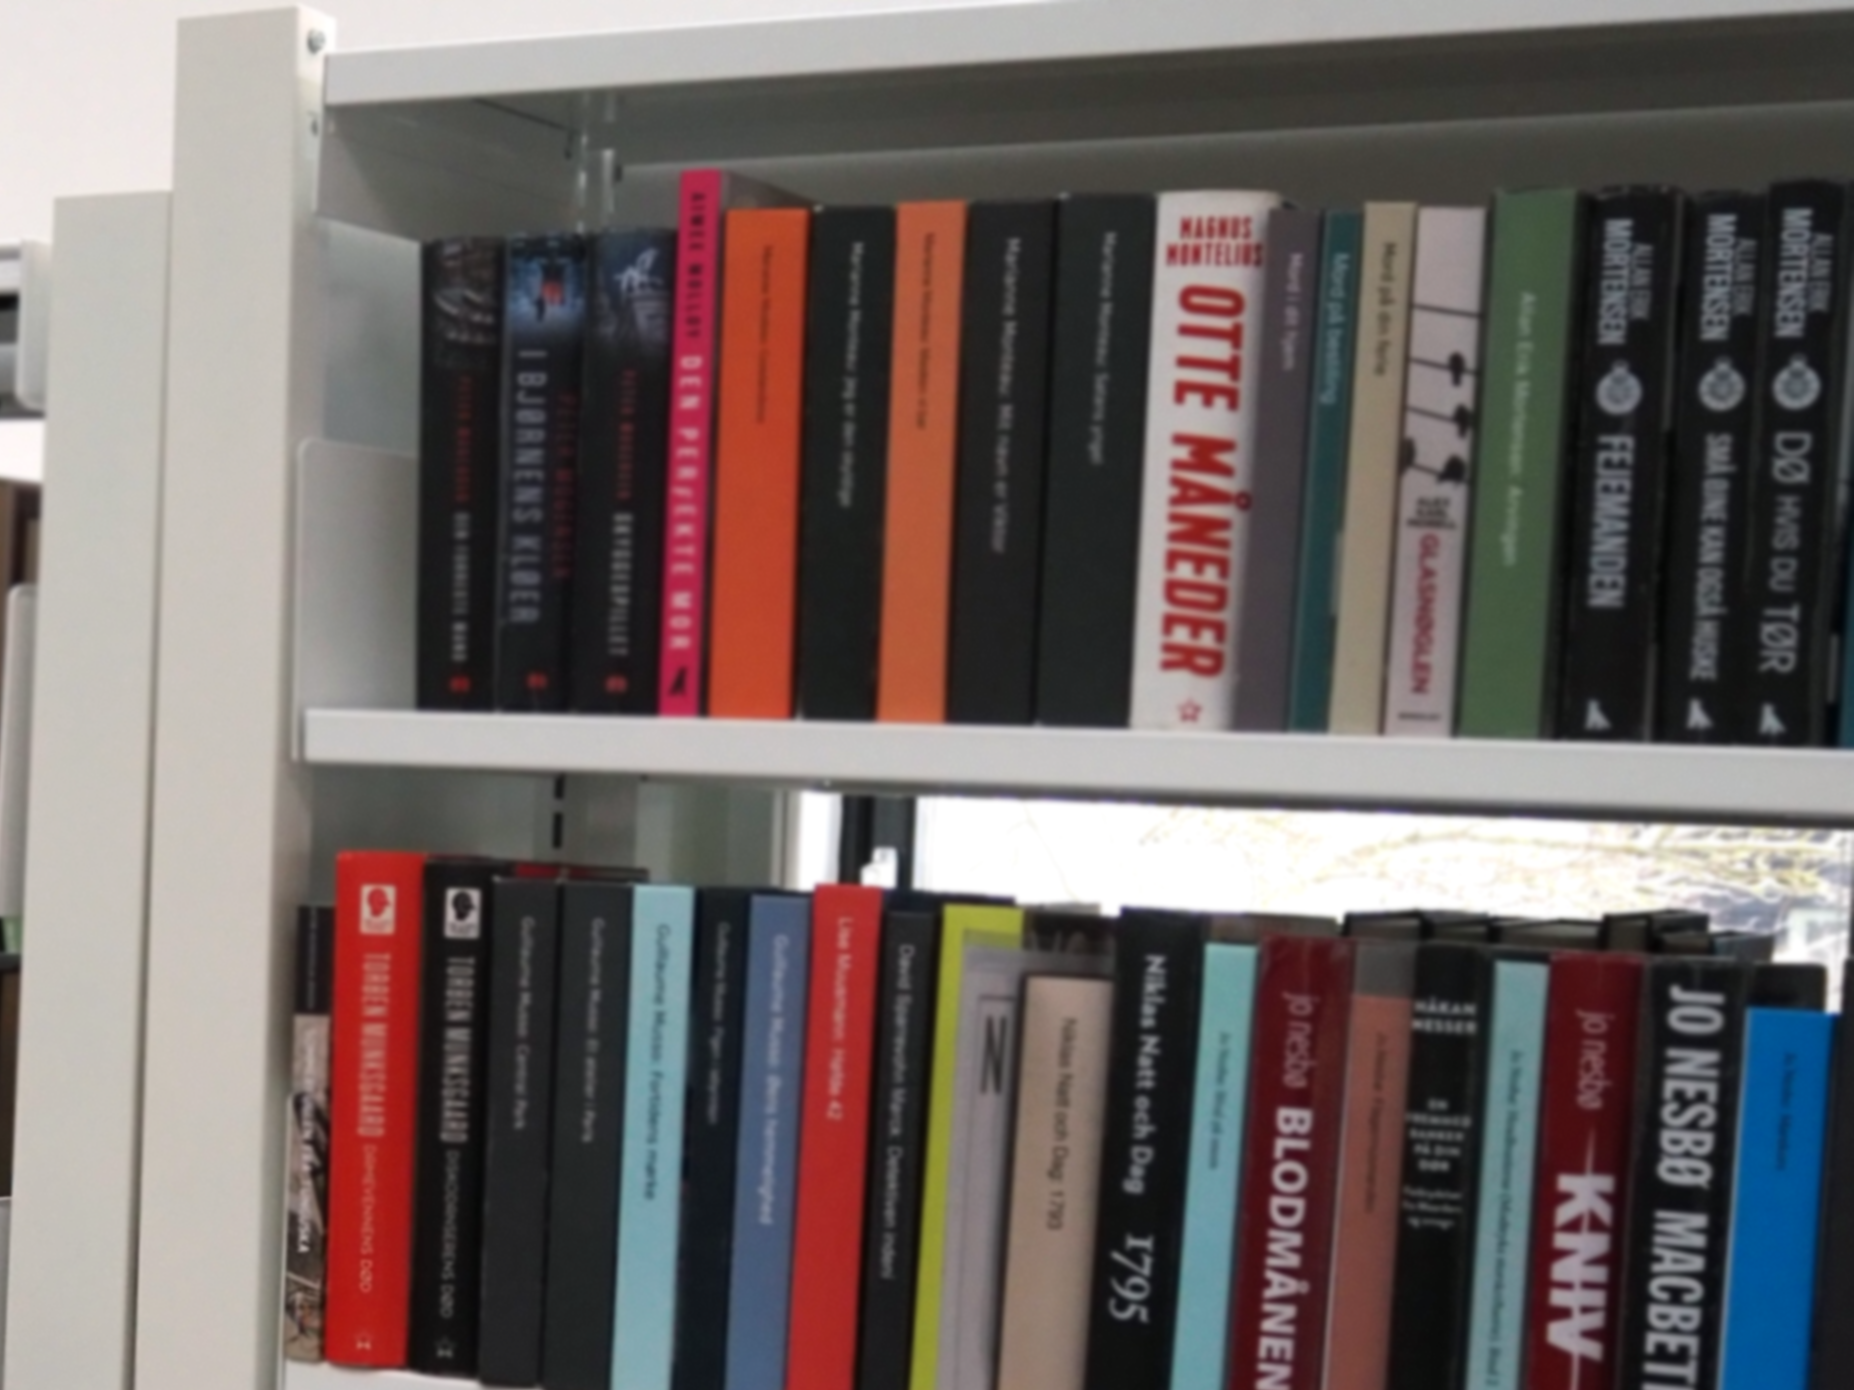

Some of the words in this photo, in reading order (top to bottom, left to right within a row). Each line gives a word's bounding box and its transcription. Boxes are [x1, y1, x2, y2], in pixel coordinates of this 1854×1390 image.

[1165, 242, 1263, 267] MONTELIUS
[1180, 217, 1254, 240] MAGNUS
[1000, 236, 1023, 317] Marianne
[1287, 252, 1306, 297] Mord
[1331, 252, 1351, 304] Mord
[1382, 241, 1401, 281] Mord
[1595, 217, 1634, 346] MORTENSEN
[1631, 241, 1654, 292] ALLAN
[1698, 212, 1738, 341] MORTENSEN
[1735, 236, 1759, 288] ALLAN
[1774, 206, 1814, 339] MORTENSEN
[1811, 231, 1836, 283] ALLAN
[1323, 307, 1347, 333] på
[1374, 283, 1396, 307] på
[1517, 292, 1538, 335] Allan
[1628, 293, 1650, 323] ERIK
[1732, 289, 1754, 318] ERIK
[1807, 283, 1831, 313] ERIK
[1175, 283, 1246, 413] OTTE
[1377, 310, 1395, 335] din
[515, 349, 548, 358] I
[1514, 339, 1534, 375] Erik
[677, 354, 704, 412] DEN
[512, 371, 548, 525] BJØRNENS
[1704, 431, 1739, 477] SMÅ
[1770, 430, 1814, 485] DØ
[669, 426, 703, 578] PERFEKTE
[1586, 435, 1635, 610] FEJEMANDEN
[1770, 494, 1796, 548] HVIS
[1158, 431, 1254, 680] MÅNEDER
[1700, 526, 1724, 564] KAN
[506, 533, 542, 626] KLØER
[1696, 567, 1728, 618] OGSÅ
[1769, 555, 1798, 593] DU
[666, 590, 694, 653] MOR
[1410, 532, 1442, 698] GLASNØGLEN
[1758, 602, 1801, 675] TØR
[1692, 620, 1719, 683] HUSKE
[361, 951, 393, 1019] TORBEN
[446, 954, 476, 1022] TORBEN
[653, 922, 673, 1007] Guillaume
[770, 933, 791, 1012] Guillaume
[897, 943, 917, 990] David
[1139, 954, 1166, 1027] Niklas
[1285, 993, 1321, 1014] jo
[1574, 1009, 1617, 1035] jo
[1667, 982, 1726, 1035] JO
[1057, 1017, 1078, 1067] Niklas
[1134, 1033, 1160, 1090] Natt
[1280, 1021, 1319, 1089] nesbø
[356, 1021, 388, 1139] MUNKSGAARD
[439, 1026, 473, 1144] MUNKSGAARD
[1054, 1073, 1074, 1108] Natt
[1577, 1041, 1615, 1110] nesbø
[1052, 1111, 1070, 1143] och
[1132, 1095, 1154, 1142] och
[1657, 1047, 1721, 1190] NESBØ
[1046, 1146, 1068, 1185] Dag:
[1123, 1145, 1152, 1194] Dag
[1046, 1189, 1064, 1230] 1793
[355, 1257, 373, 1294] DØD
[1109, 1232, 1154, 1324] 1795
[1548, 1172, 1615, 1363] KNIV
[439, 1282, 457, 1320] DØD
